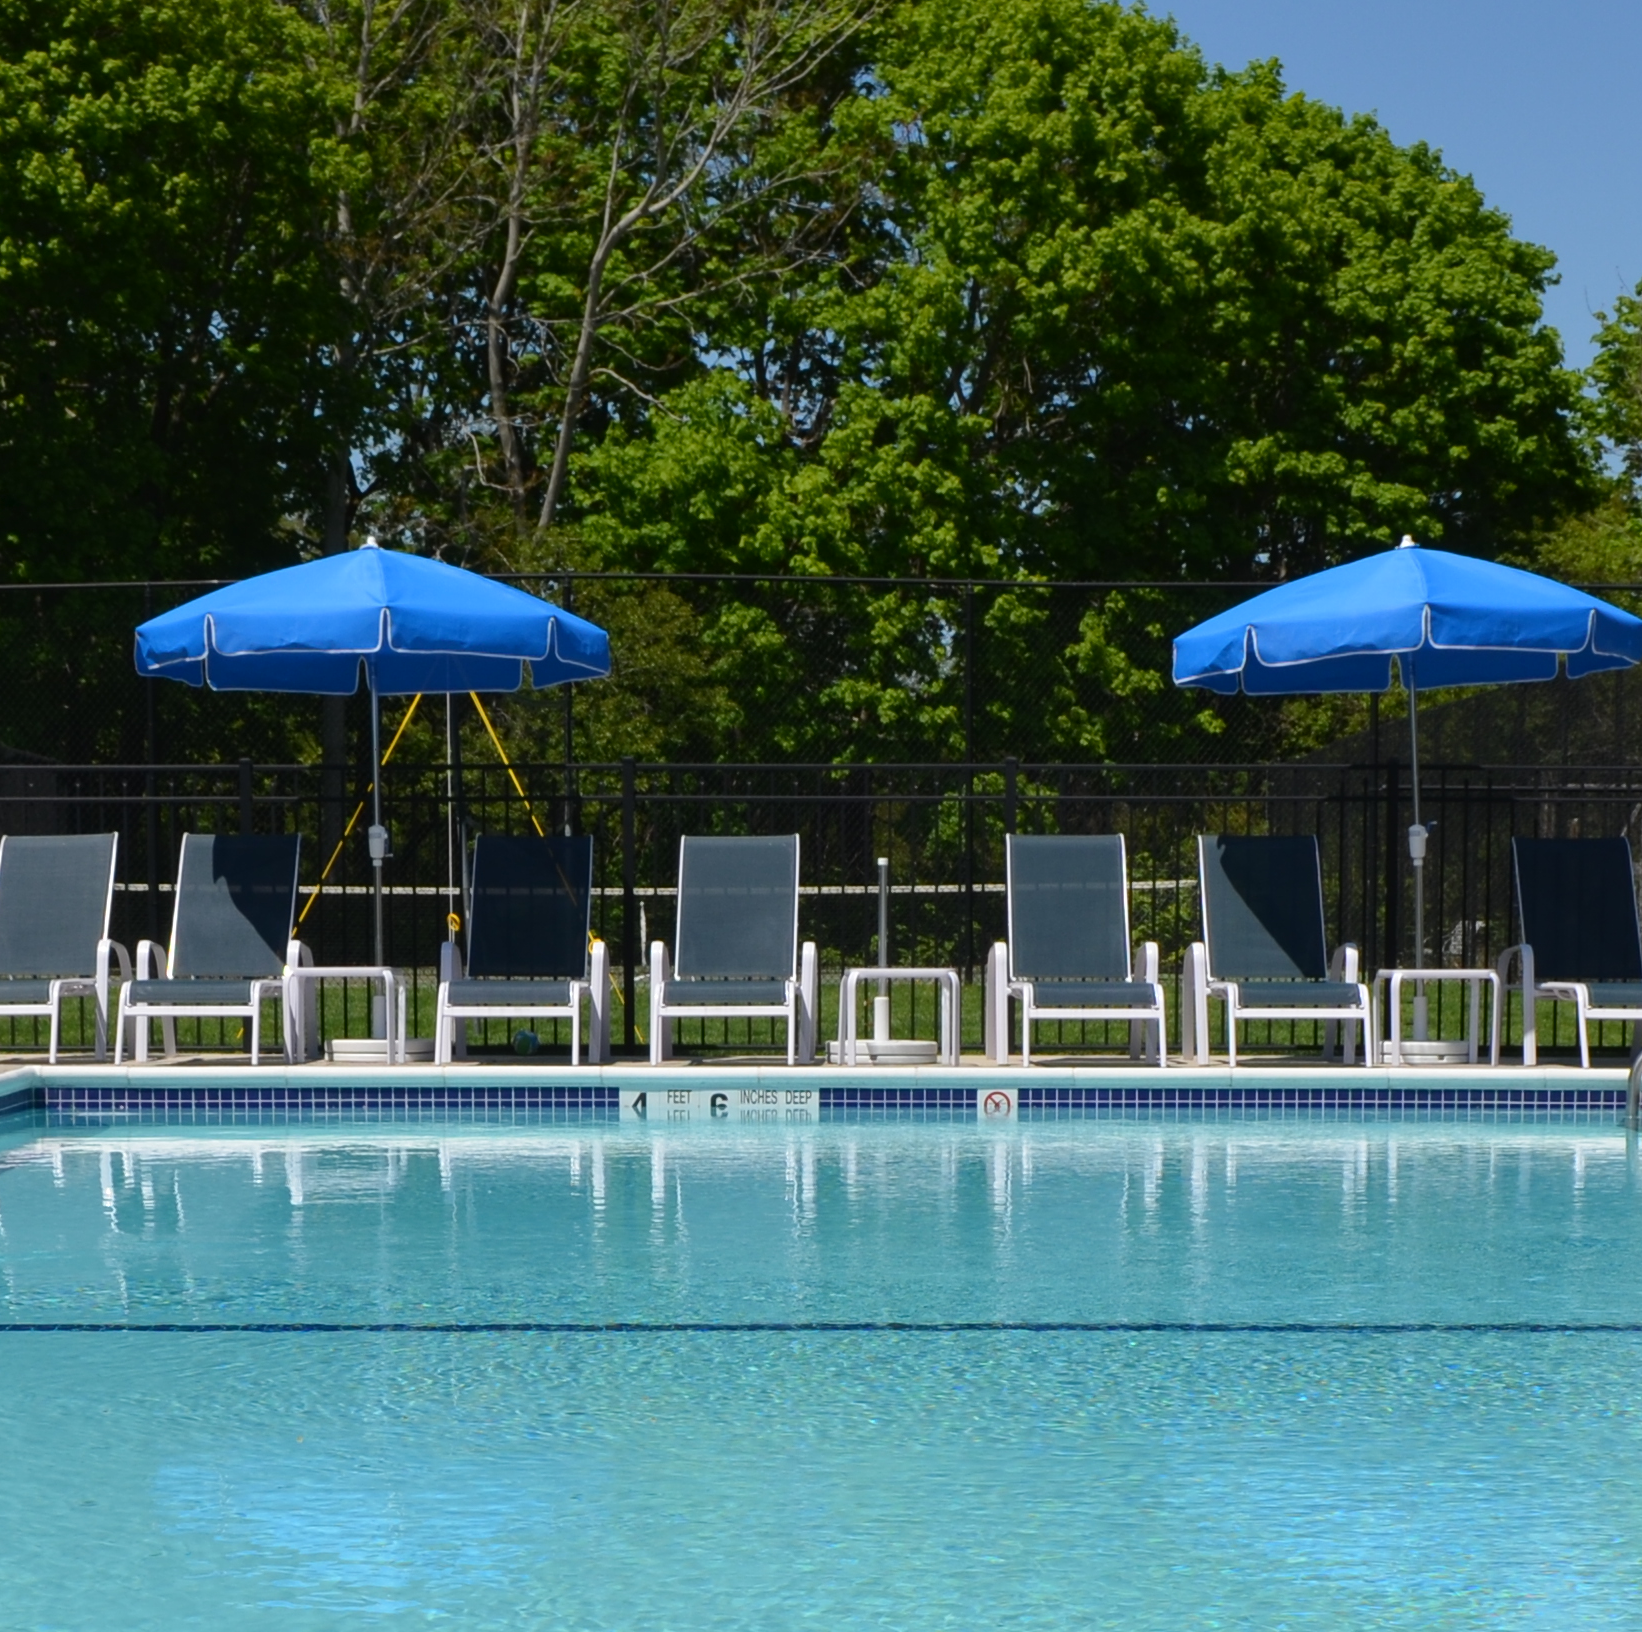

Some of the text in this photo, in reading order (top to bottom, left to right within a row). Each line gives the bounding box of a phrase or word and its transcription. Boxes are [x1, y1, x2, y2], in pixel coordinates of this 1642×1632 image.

[667, 1089, 692, 1104] FEET
[740, 1089, 778, 1105] INCHES
[785, 1089, 812, 1105] DEEP
